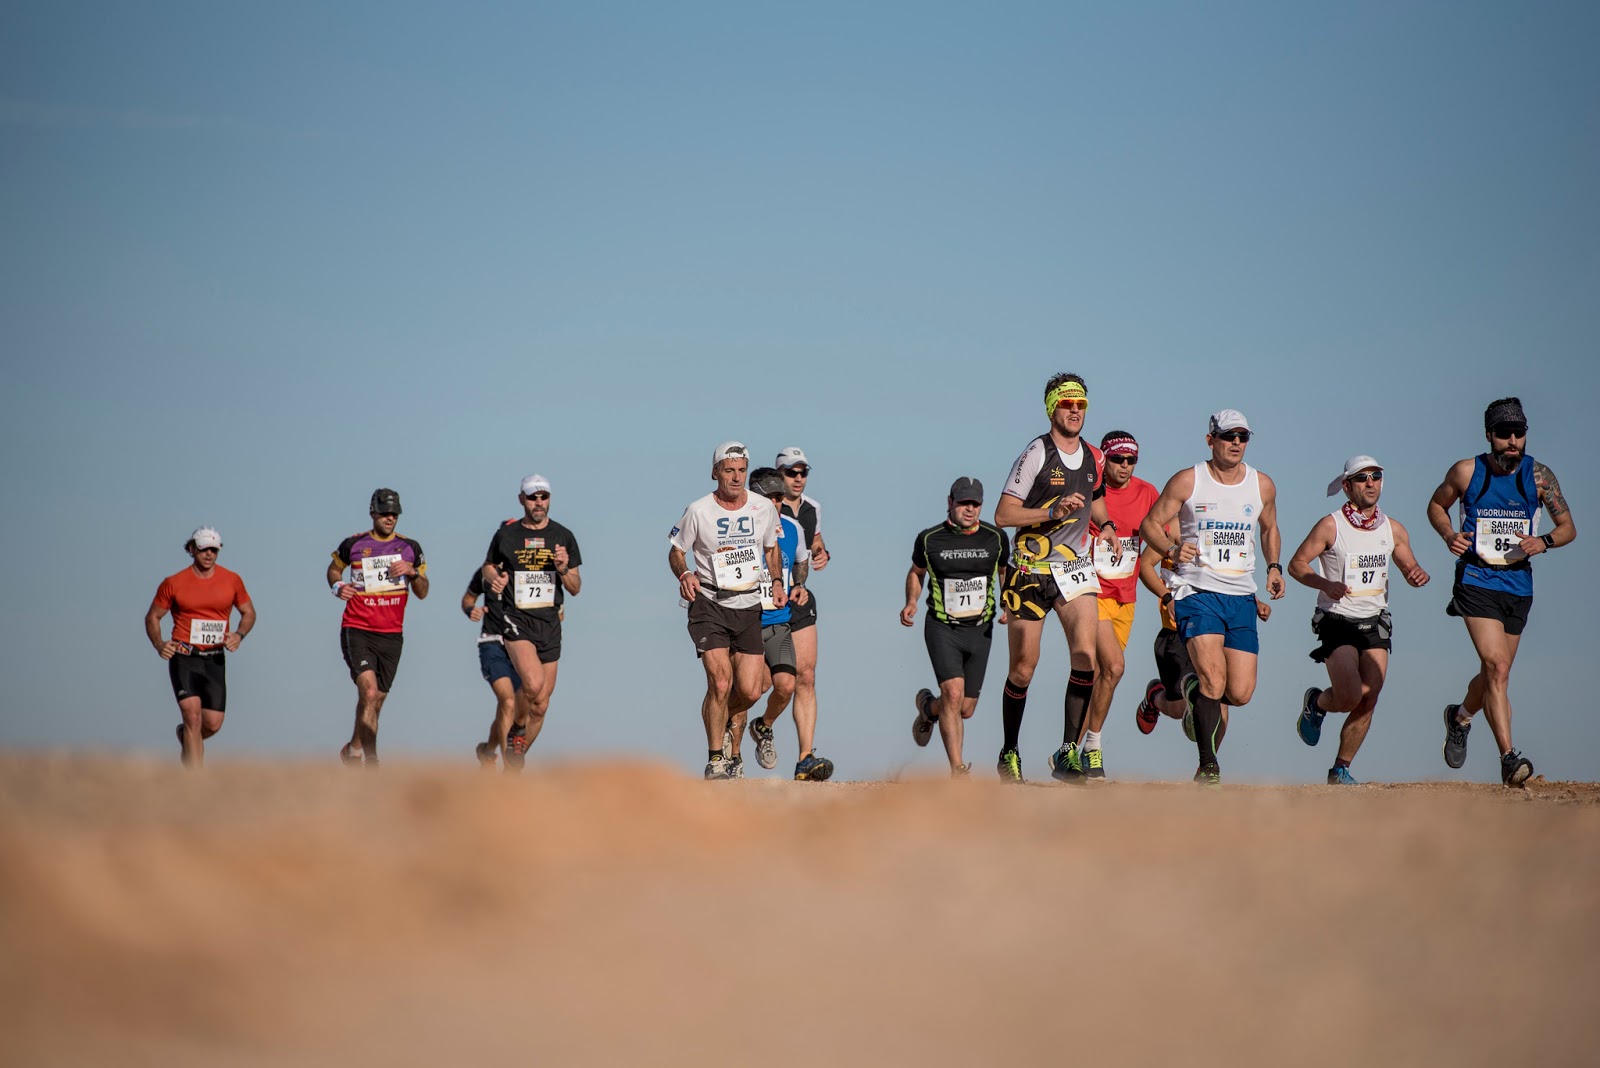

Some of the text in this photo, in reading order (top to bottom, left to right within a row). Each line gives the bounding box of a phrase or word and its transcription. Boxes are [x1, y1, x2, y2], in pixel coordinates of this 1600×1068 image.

[1491, 520, 1524, 530] SAHARA
[1213, 531, 1245, 540] SAHARA
[718, 538, 756, 546] semicrol.es
[1494, 537, 1510, 552] 85
[725, 549, 755, 561] SAHARA
[1218, 548, 1230, 562] 14
[1358, 554, 1386, 563] SAHARA
[726, 556, 756, 566] MARATHON
[377, 571, 390, 581] 62
[526, 573, 552, 581] SAHARA
[735, 567, 742, 579] 3
[1071, 571, 1088, 584] 92
[1362, 570, 1375, 584] 87
[955, 580, 982, 588] SAHARA
[529, 587, 541, 598] 72
[960, 595, 971, 606] 71
[202, 634, 216, 645] 102
